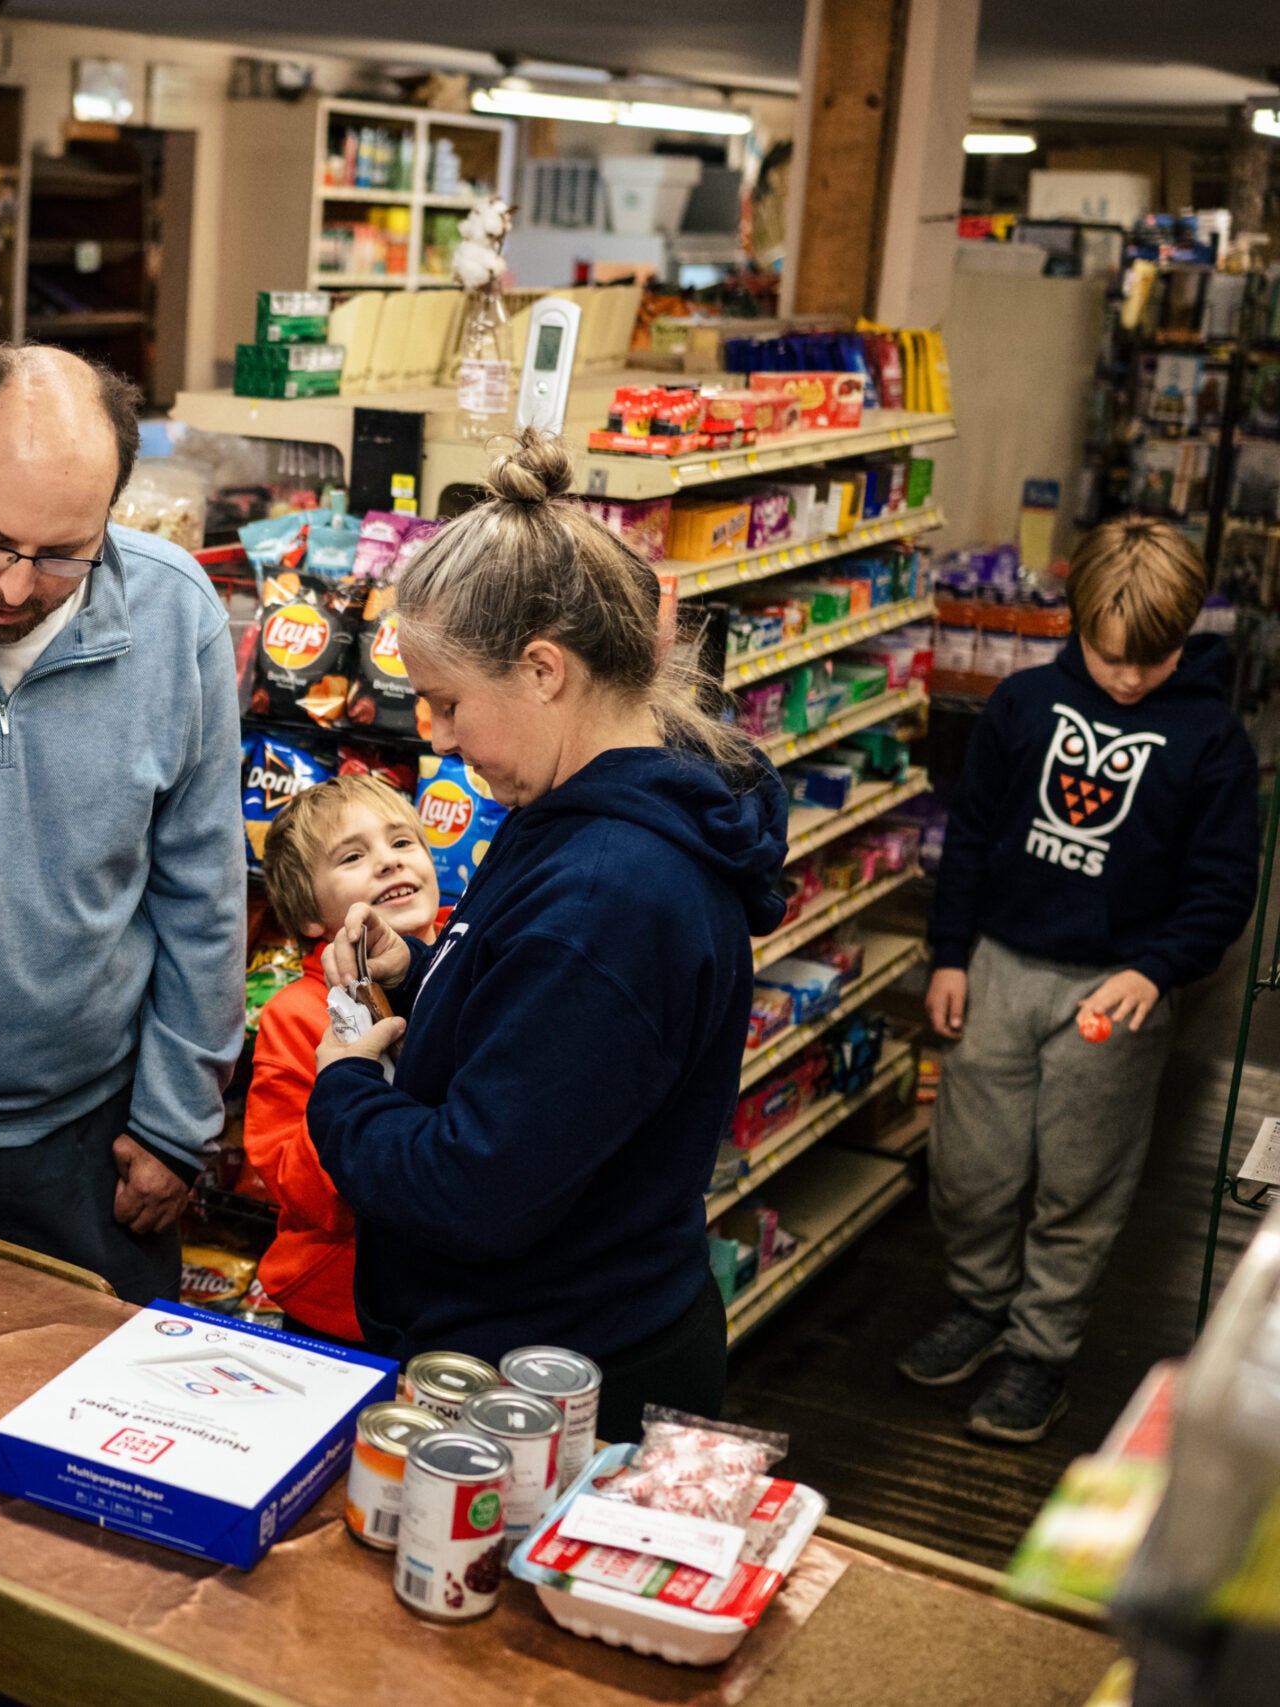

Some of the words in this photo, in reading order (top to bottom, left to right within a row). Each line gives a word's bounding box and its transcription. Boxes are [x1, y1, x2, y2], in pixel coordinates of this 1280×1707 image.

[267, 616, 326, 655] Lay's
[248, 766, 303, 795] Dorit
[421, 794, 470, 834] Lay's
[1025, 828, 1106, 877] mcs
[193, 1311, 233, 1325] JAMMING
[235, 1322, 274, 1336] PREVENT
[276, 1332, 287, 1340] TO
[290, 1337, 347, 1357] ENGINEERED
[78, 1398, 129, 1418] Paper
[124, 1435, 160, 1449] RED
[132, 1415, 251, 1453] Multipurpose
[116, 1441, 150, 1455] TRU
[66, 1463, 133, 1492] Multipurpose
[134, 1484, 164, 1501] Paper
